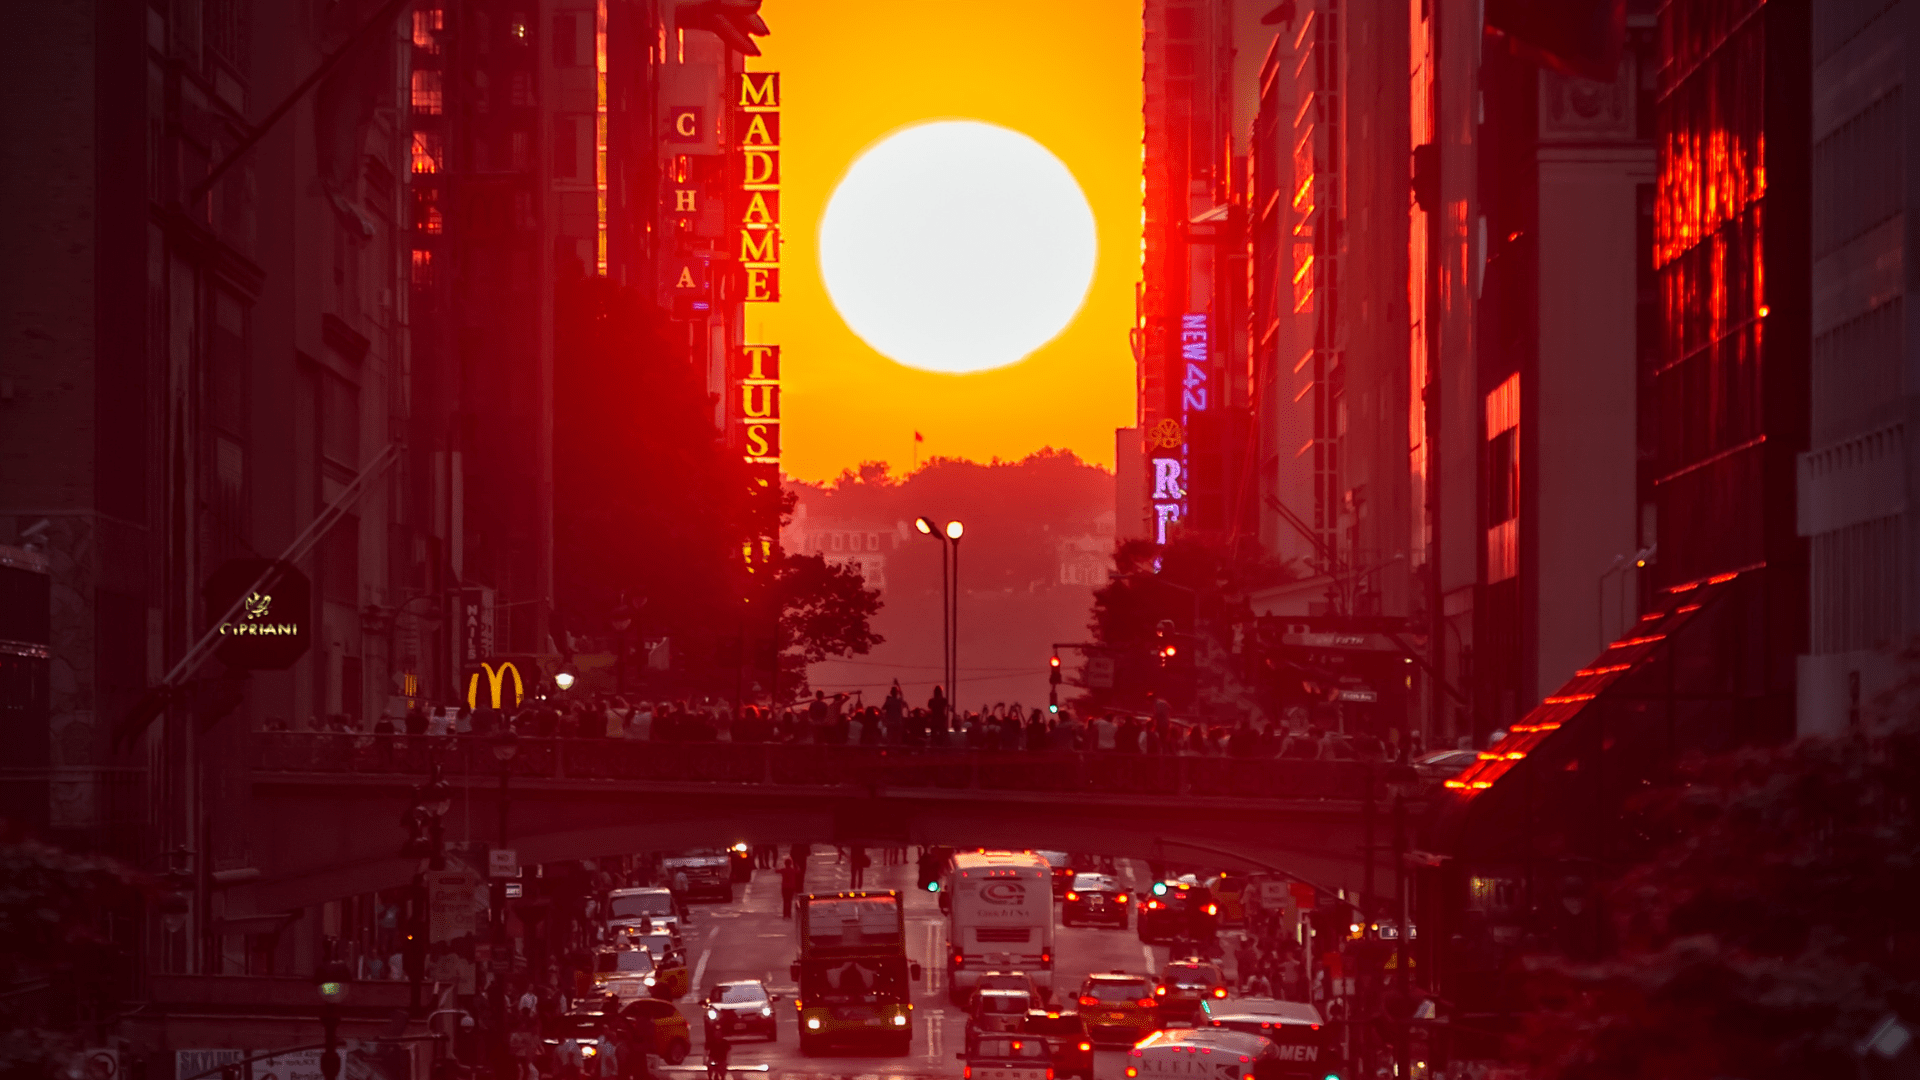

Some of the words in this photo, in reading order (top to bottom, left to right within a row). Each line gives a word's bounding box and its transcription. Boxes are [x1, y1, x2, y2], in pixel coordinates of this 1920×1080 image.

[739, 73, 776, 301] MADAME
[1182, 313, 1207, 361] NEW
[1142, 1060, 1209, 1074] KLEIN
